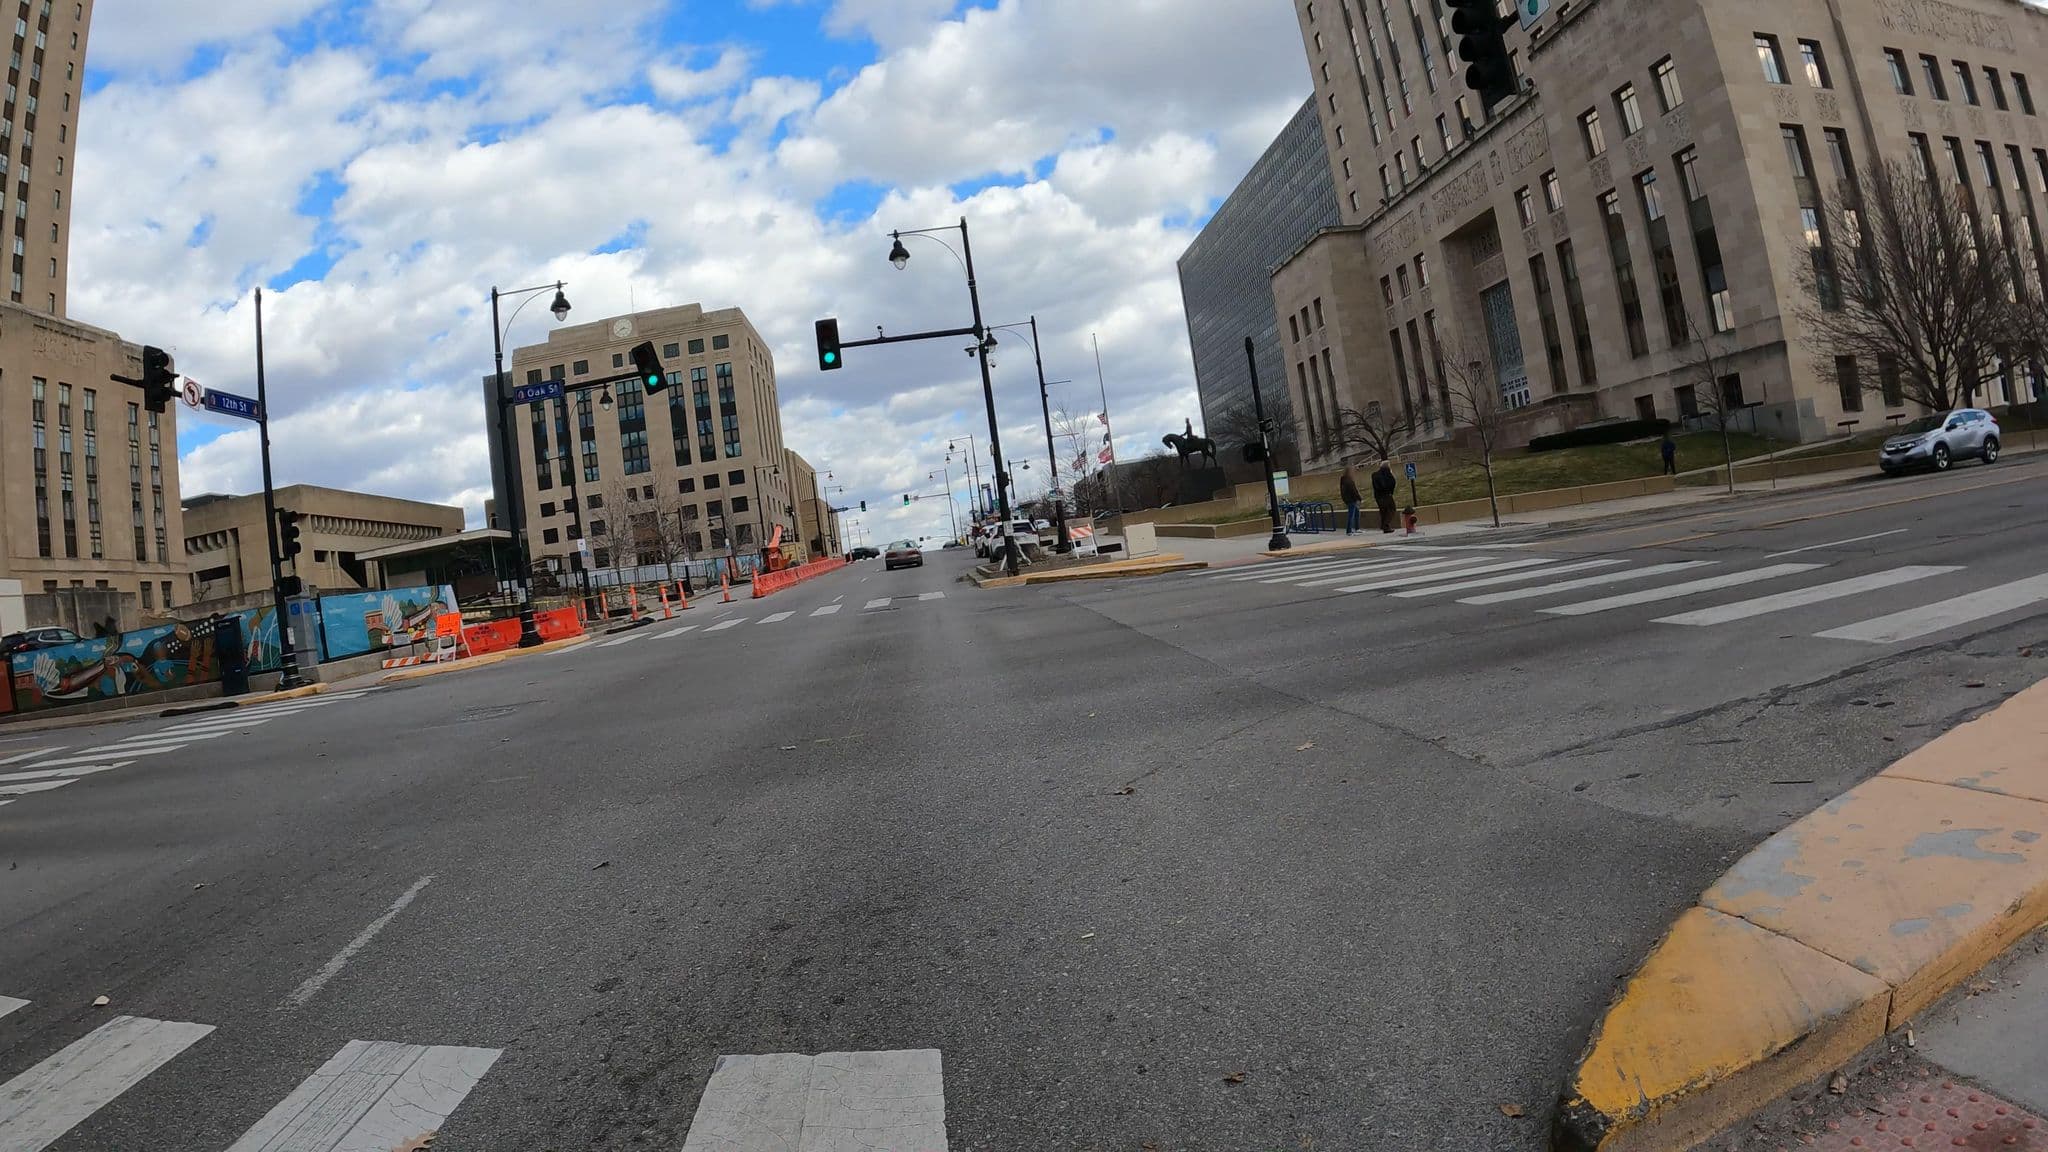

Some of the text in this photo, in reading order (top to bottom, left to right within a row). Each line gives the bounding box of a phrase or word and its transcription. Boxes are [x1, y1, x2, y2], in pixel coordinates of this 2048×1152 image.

[527, 384, 558, 398] Oak St
[222, 397, 247, 412] 12th St
